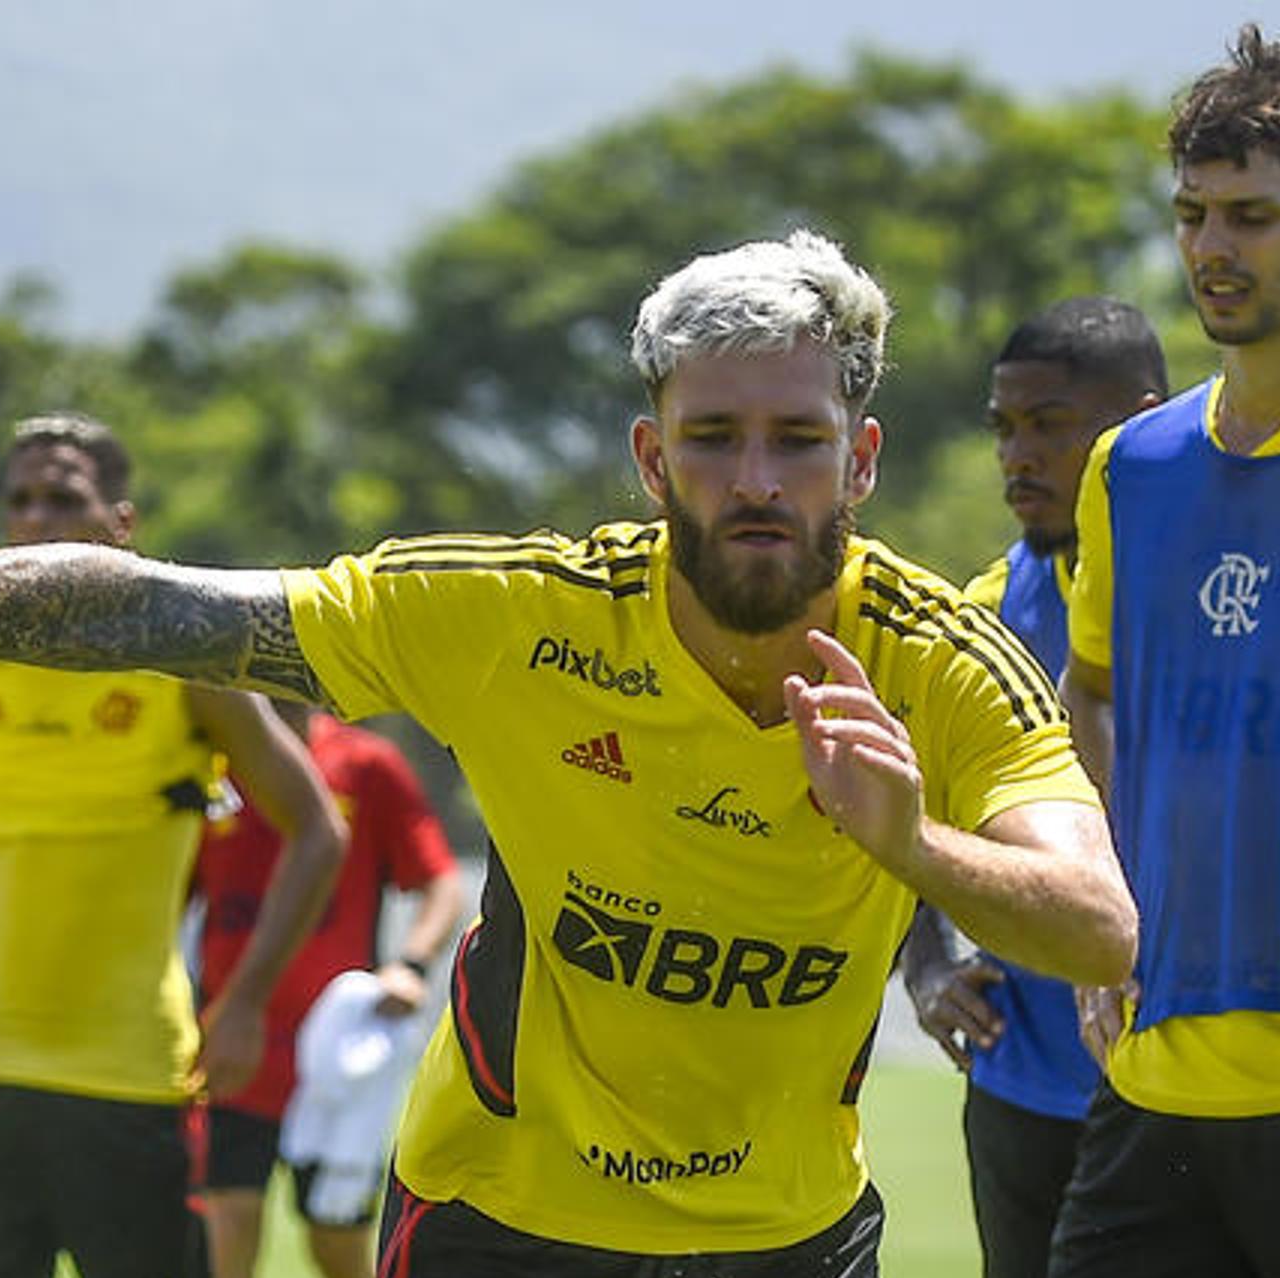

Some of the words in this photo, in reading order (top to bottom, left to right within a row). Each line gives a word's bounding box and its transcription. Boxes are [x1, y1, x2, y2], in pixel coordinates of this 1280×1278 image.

[561, 748, 632, 785] adidas
[676, 787, 771, 838] Luvix
[567, 869, 662, 917] banco
[646, 928, 850, 1009] BRB
